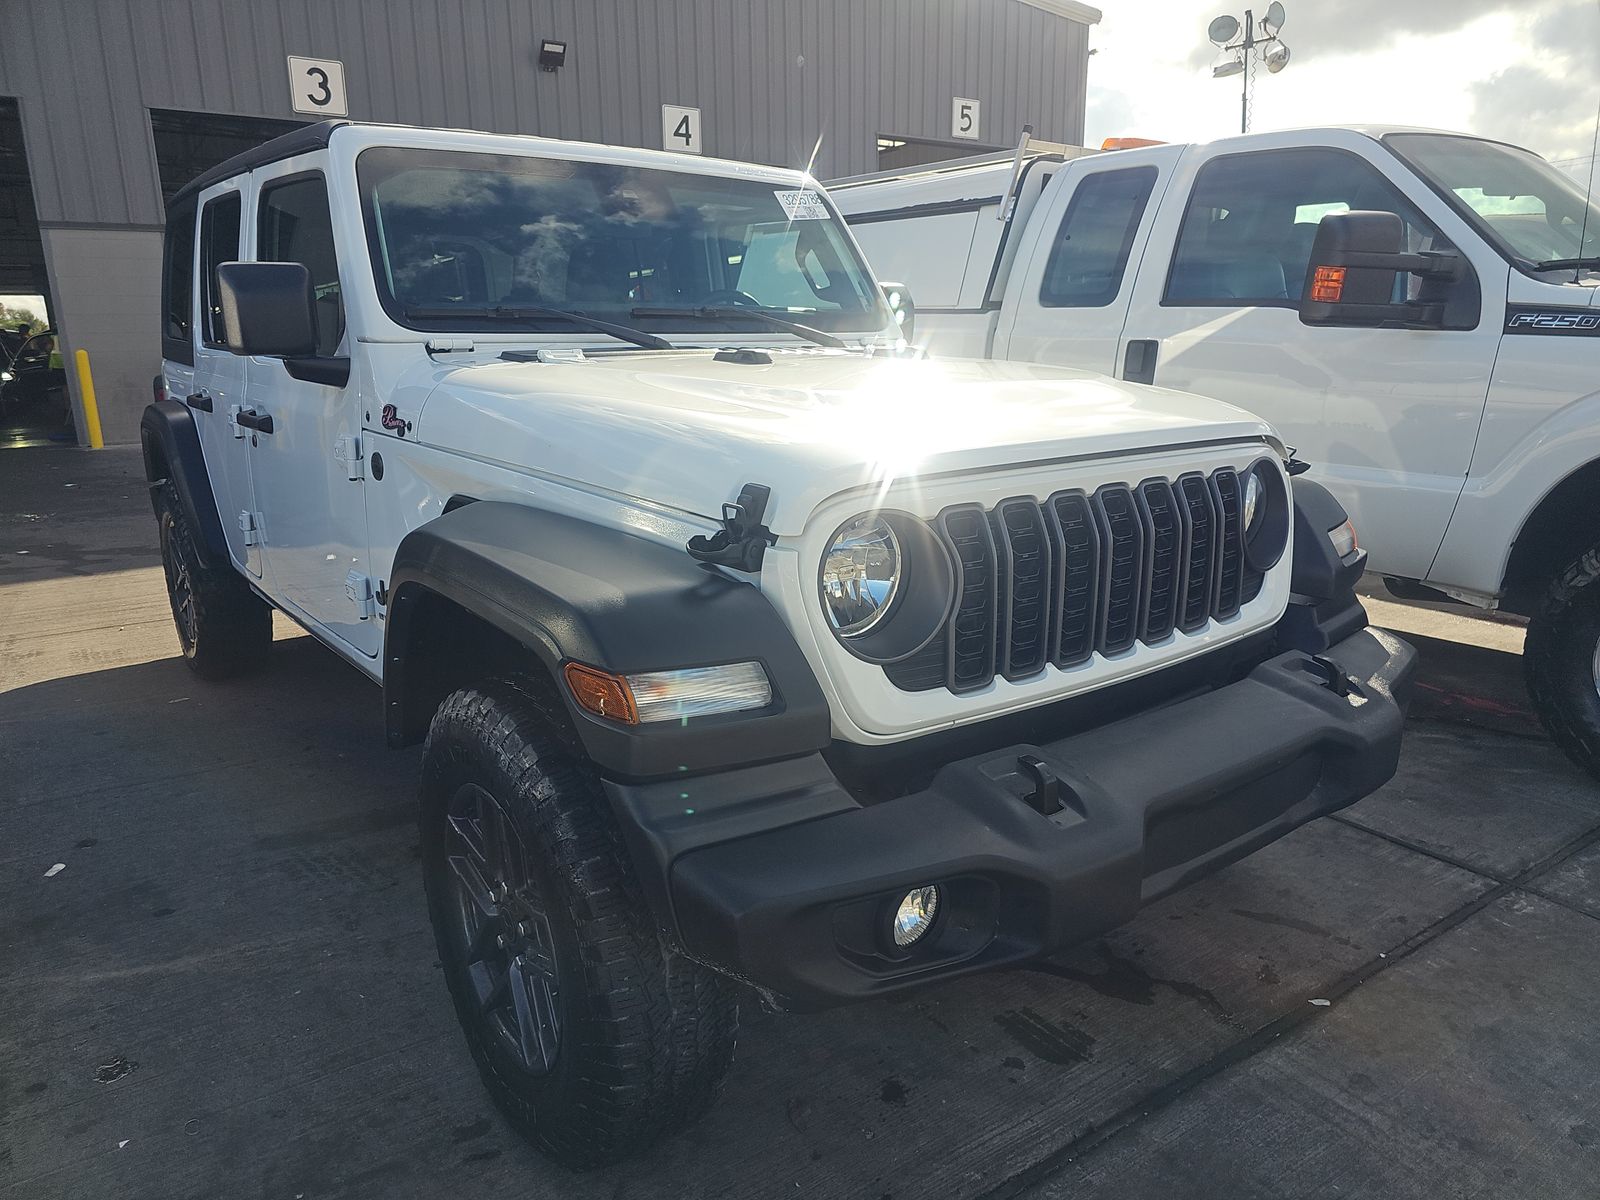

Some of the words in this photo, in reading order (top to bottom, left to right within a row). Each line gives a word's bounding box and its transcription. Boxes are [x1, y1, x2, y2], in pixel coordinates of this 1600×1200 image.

[306, 67, 331, 106] 3
[673, 115, 692, 146] 4
[960, 105, 972, 132] 5
